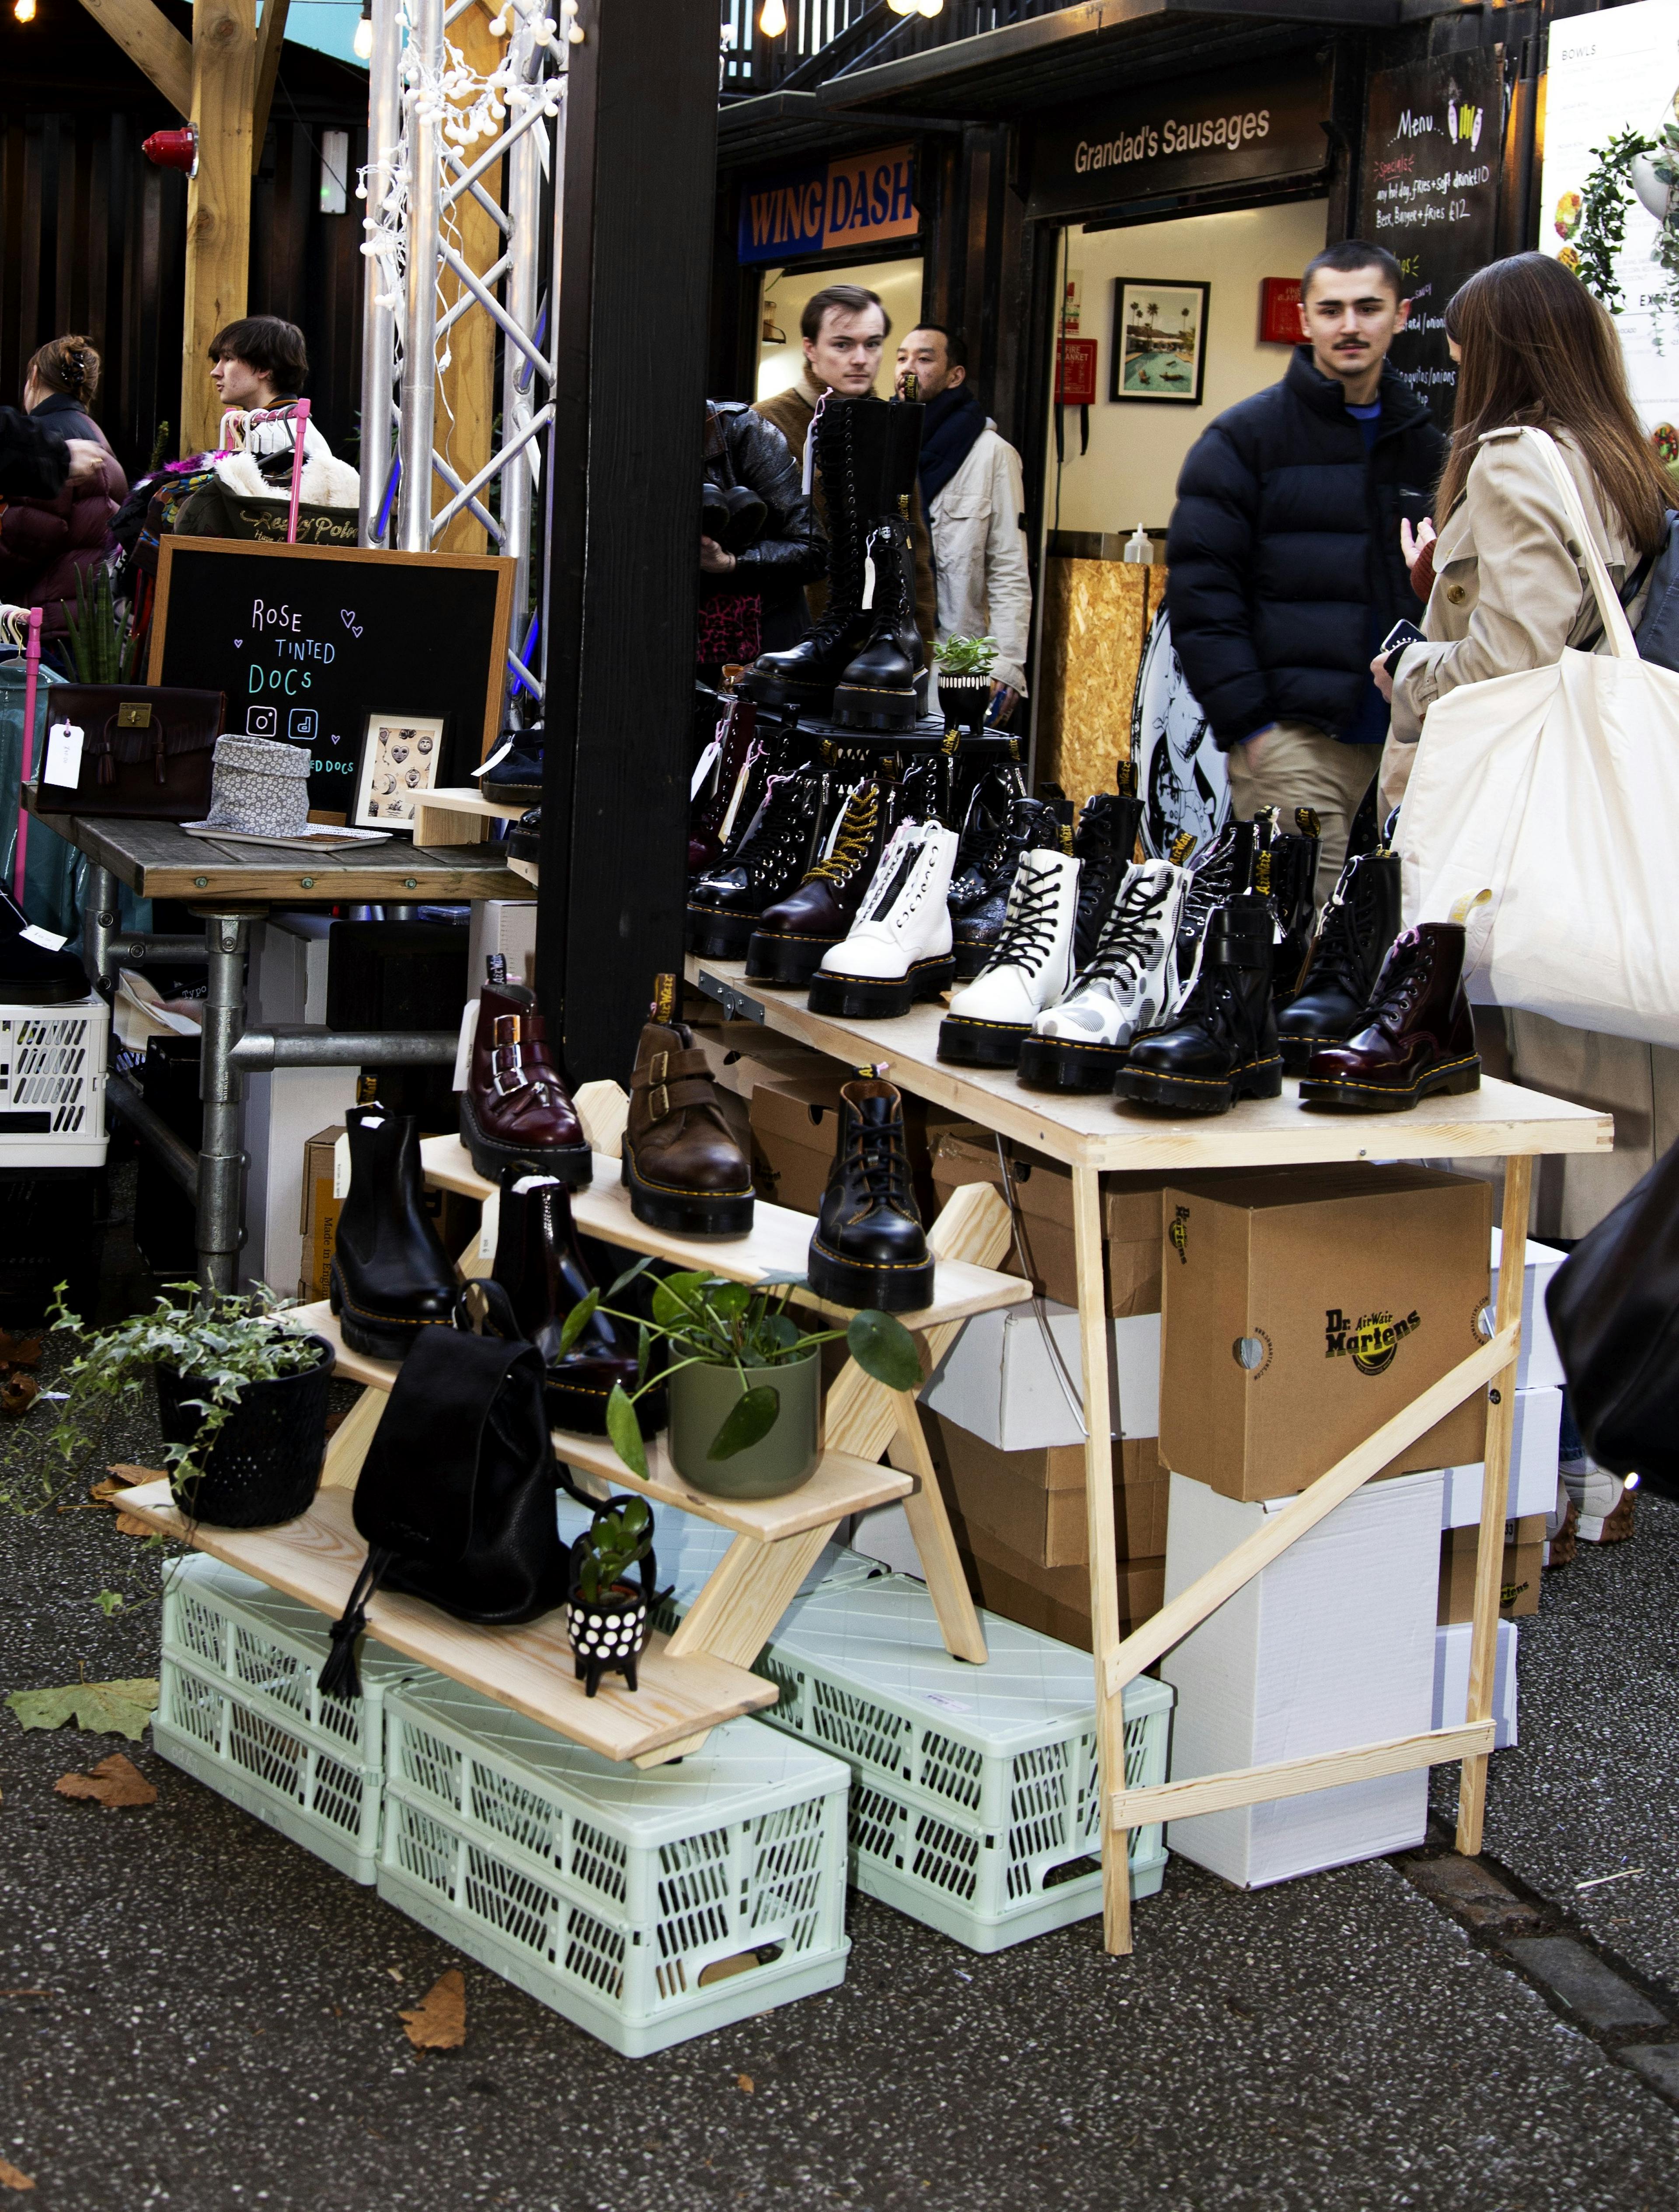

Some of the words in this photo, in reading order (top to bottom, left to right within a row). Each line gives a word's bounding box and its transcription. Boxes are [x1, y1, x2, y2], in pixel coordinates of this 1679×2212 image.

[1562, 45, 1596, 60] BOWLS
[1075, 125, 1158, 173] Grandad's
[1162, 110, 1270, 153] Sausages
[751, 181, 823, 247] WING
[829, 160, 913, 233] DASH
[315, 518, 359, 541] Poin
[252, 599, 302, 632] ROSE
[275, 640, 335, 664] TINTED
[249, 664, 311, 695] DOCS
[941, 729, 958, 755] AirWair
[1169, 832, 1193, 864] AirWair
[1256, 850, 1271, 895] AirWair
[490, 955, 505, 984] AirWair
[182, 985, 207, 1000] Typo
[657, 974, 672, 1023] AirWair
[323, 1217, 333, 1245] Made
[323, 1249, 331, 1259] in
[320, 1262, 331, 1300] Englan
[1325, 1308, 1351, 1333] Dr.
[1355, 1311, 1393, 1331] AirWair
[1325, 1310, 1421, 1358] Martens
[1500, 1581, 1529, 1599] rtens
